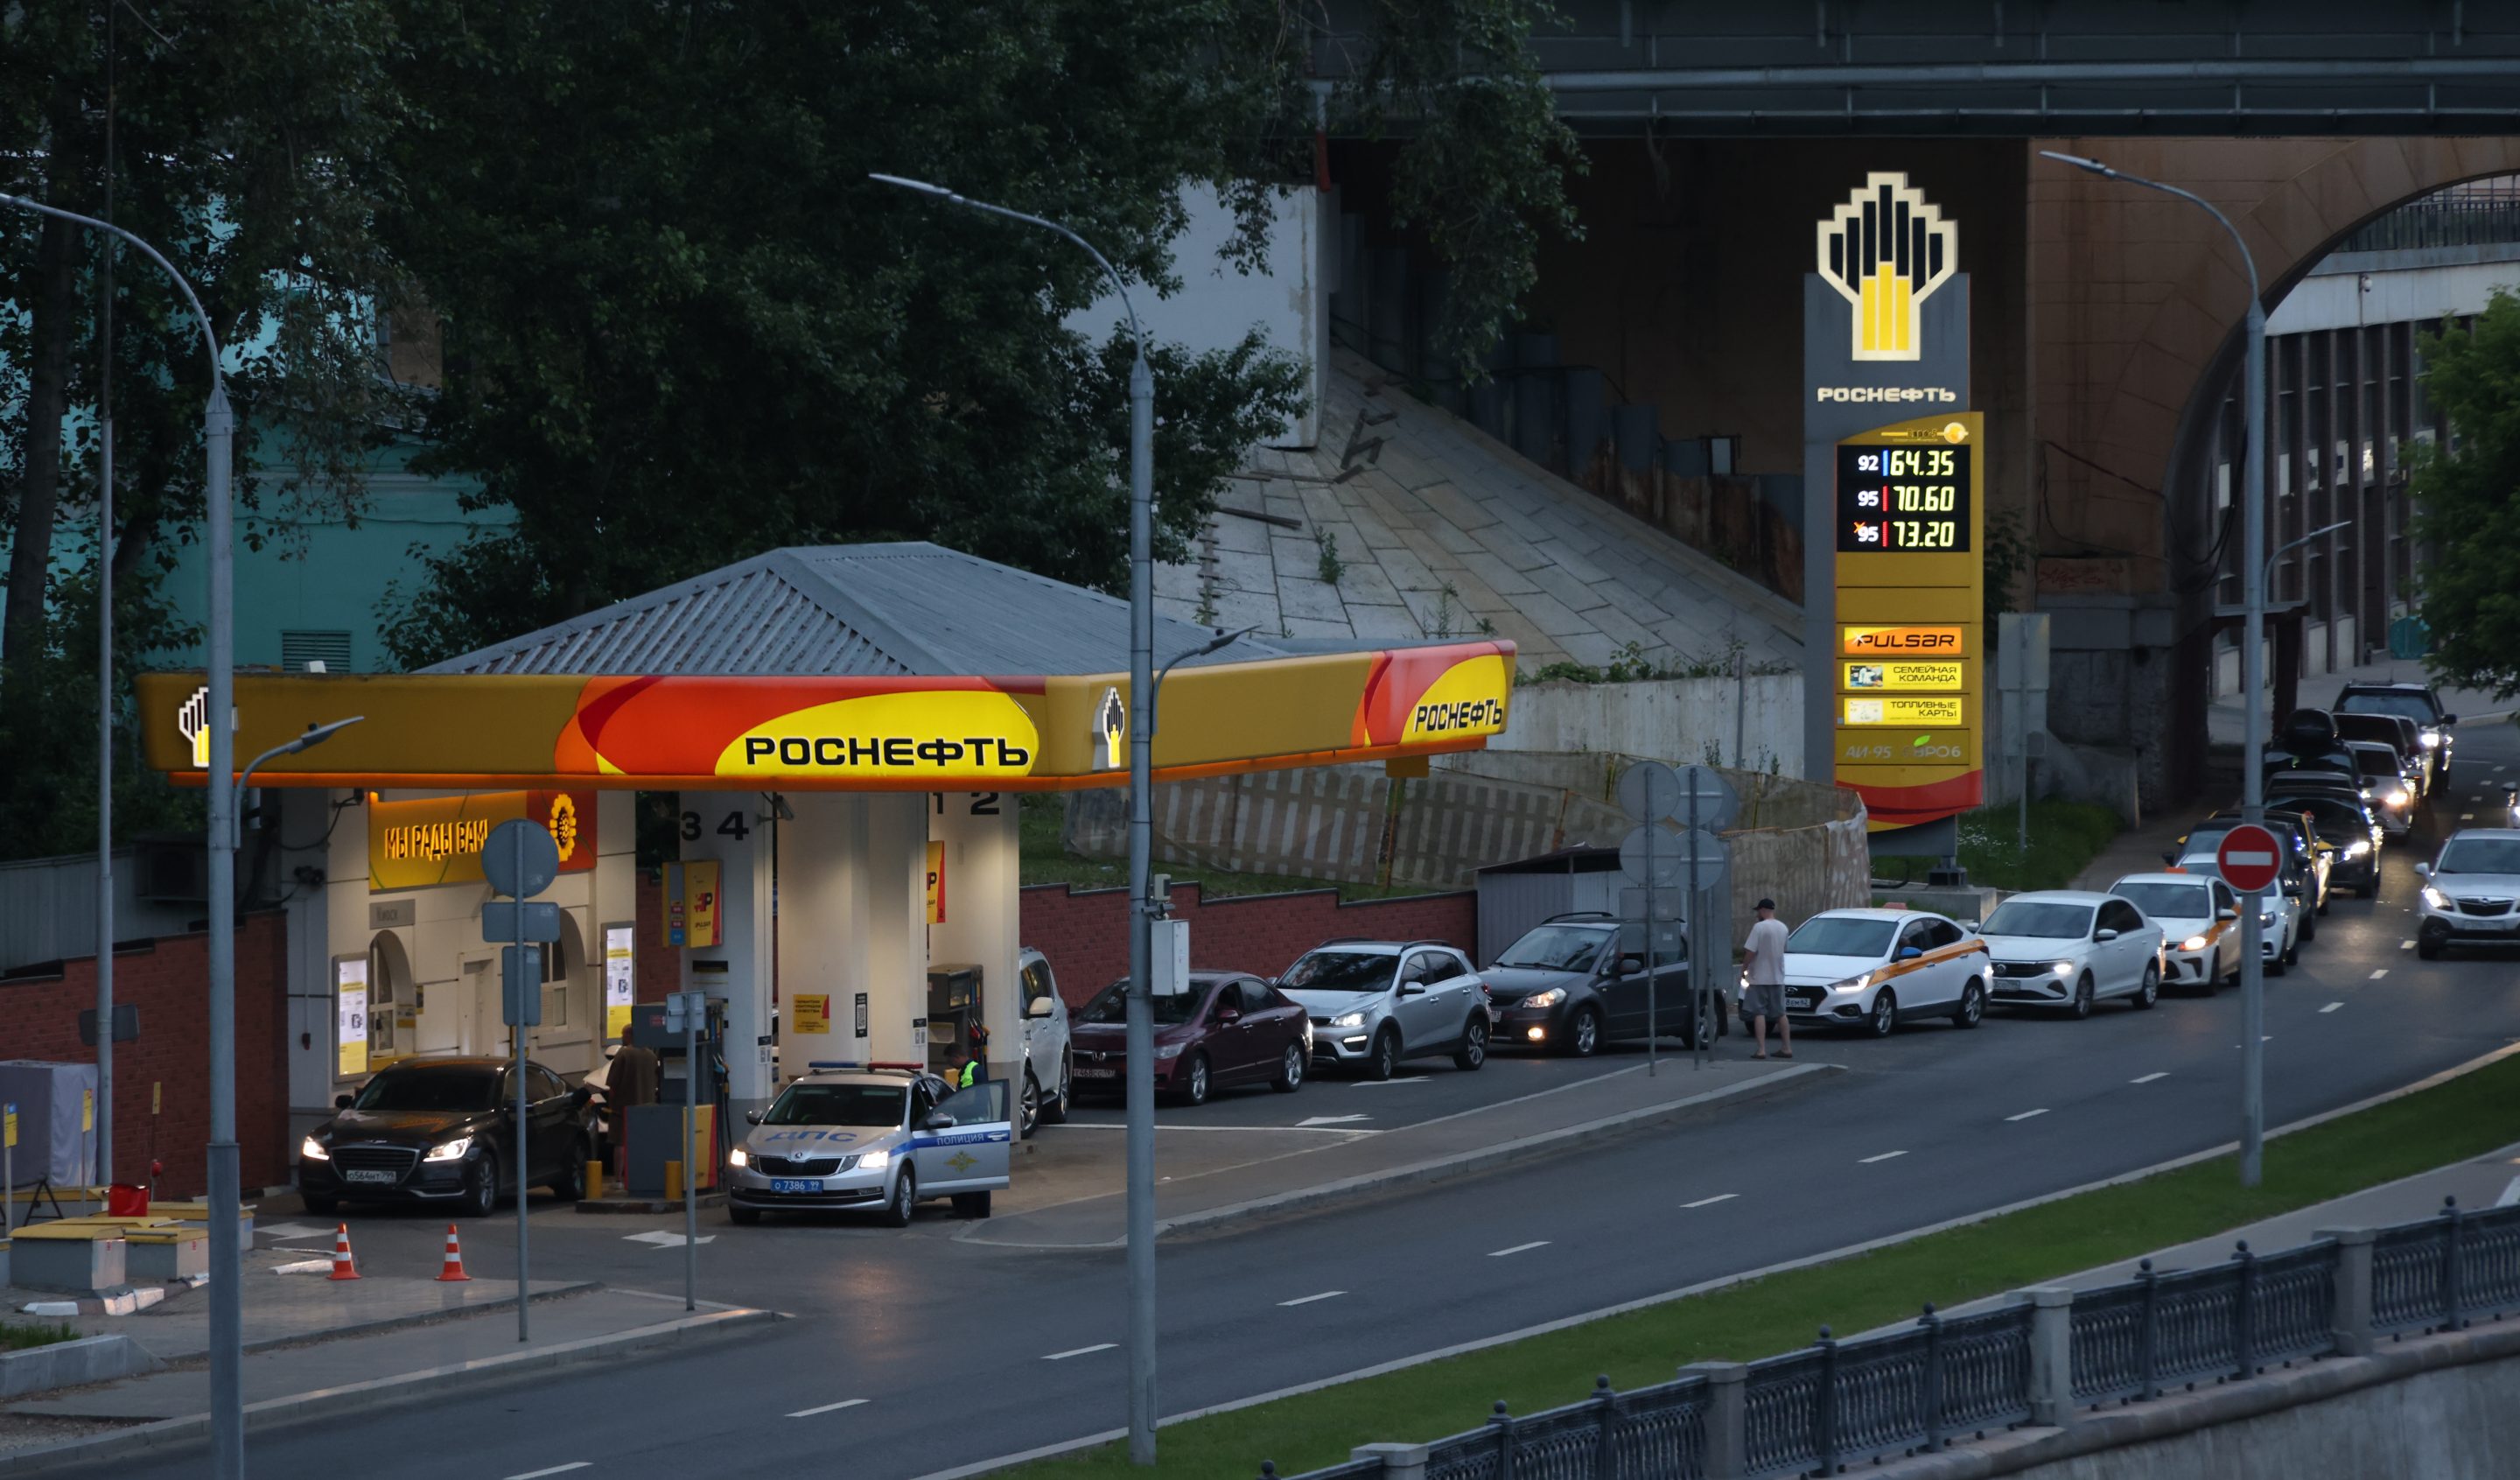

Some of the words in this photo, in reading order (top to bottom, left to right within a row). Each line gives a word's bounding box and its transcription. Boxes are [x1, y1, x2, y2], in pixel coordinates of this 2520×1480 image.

[1816, 387, 1956, 403] РОСНЕФТЬ
[1858, 455, 1880, 471] 92
[1890, 450, 1955, 476] 64.35
[1858, 491, 1880, 507] 95
[1893, 486, 1956, 512] 70.60
[1858, 526, 1880, 542] 95
[1893, 521, 1956, 547] 73.20
[1893, 665, 1957, 674] СЕМЕЙНАЯ
[1899, 674, 1956, 683] КОМАНДА
[1412, 698, 1502, 733] РОСНЕФТЬ
[746, 737, 1029, 767] РОСНЕФТЬ
[970, 792, 1000, 815] 2
[681, 810, 702, 841] 3
[717, 810, 749, 840] 4
[385, 826, 410, 859] МЫ
[411, 823, 453, 861] РАДЫ
[765, 1131, 858, 1142] ДПС
[937, 1133, 984, 1146] ПОЛИЦИЯ
[783, 1181, 806, 1190] 7386
[810, 1181, 820, 1190] 99
